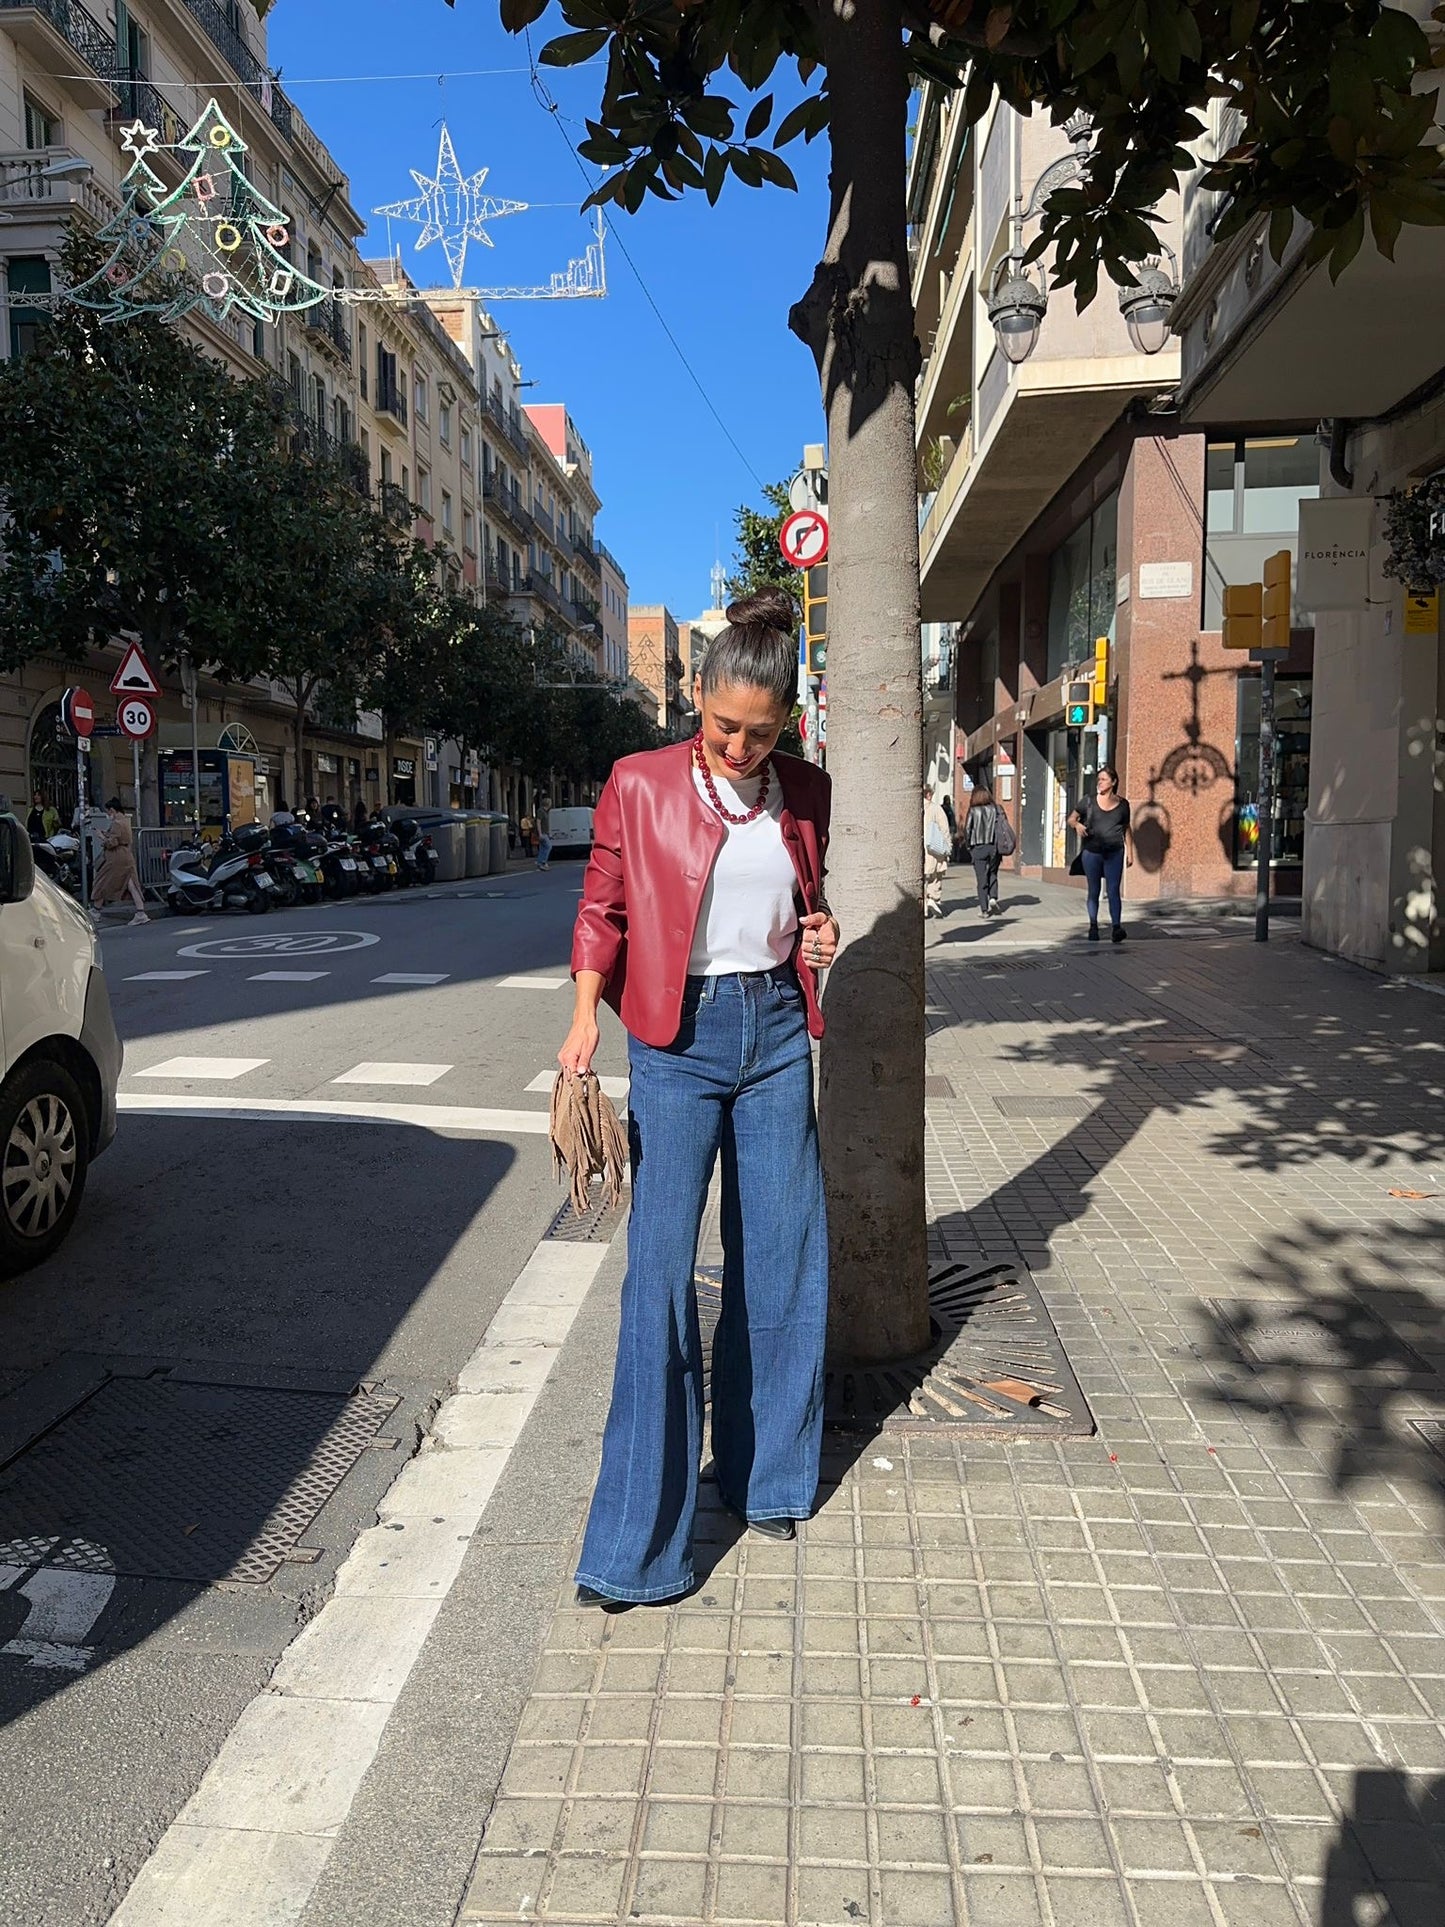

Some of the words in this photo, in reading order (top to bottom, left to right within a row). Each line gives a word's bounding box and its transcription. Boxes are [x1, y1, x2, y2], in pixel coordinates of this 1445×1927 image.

[1430, 511, 1445, 540] F
[1304, 550, 1366, 559] FLORENCIA
[126, 710, 148, 725] 30
[427, 740, 435, 759] P
[220, 936, 338, 951] 30
